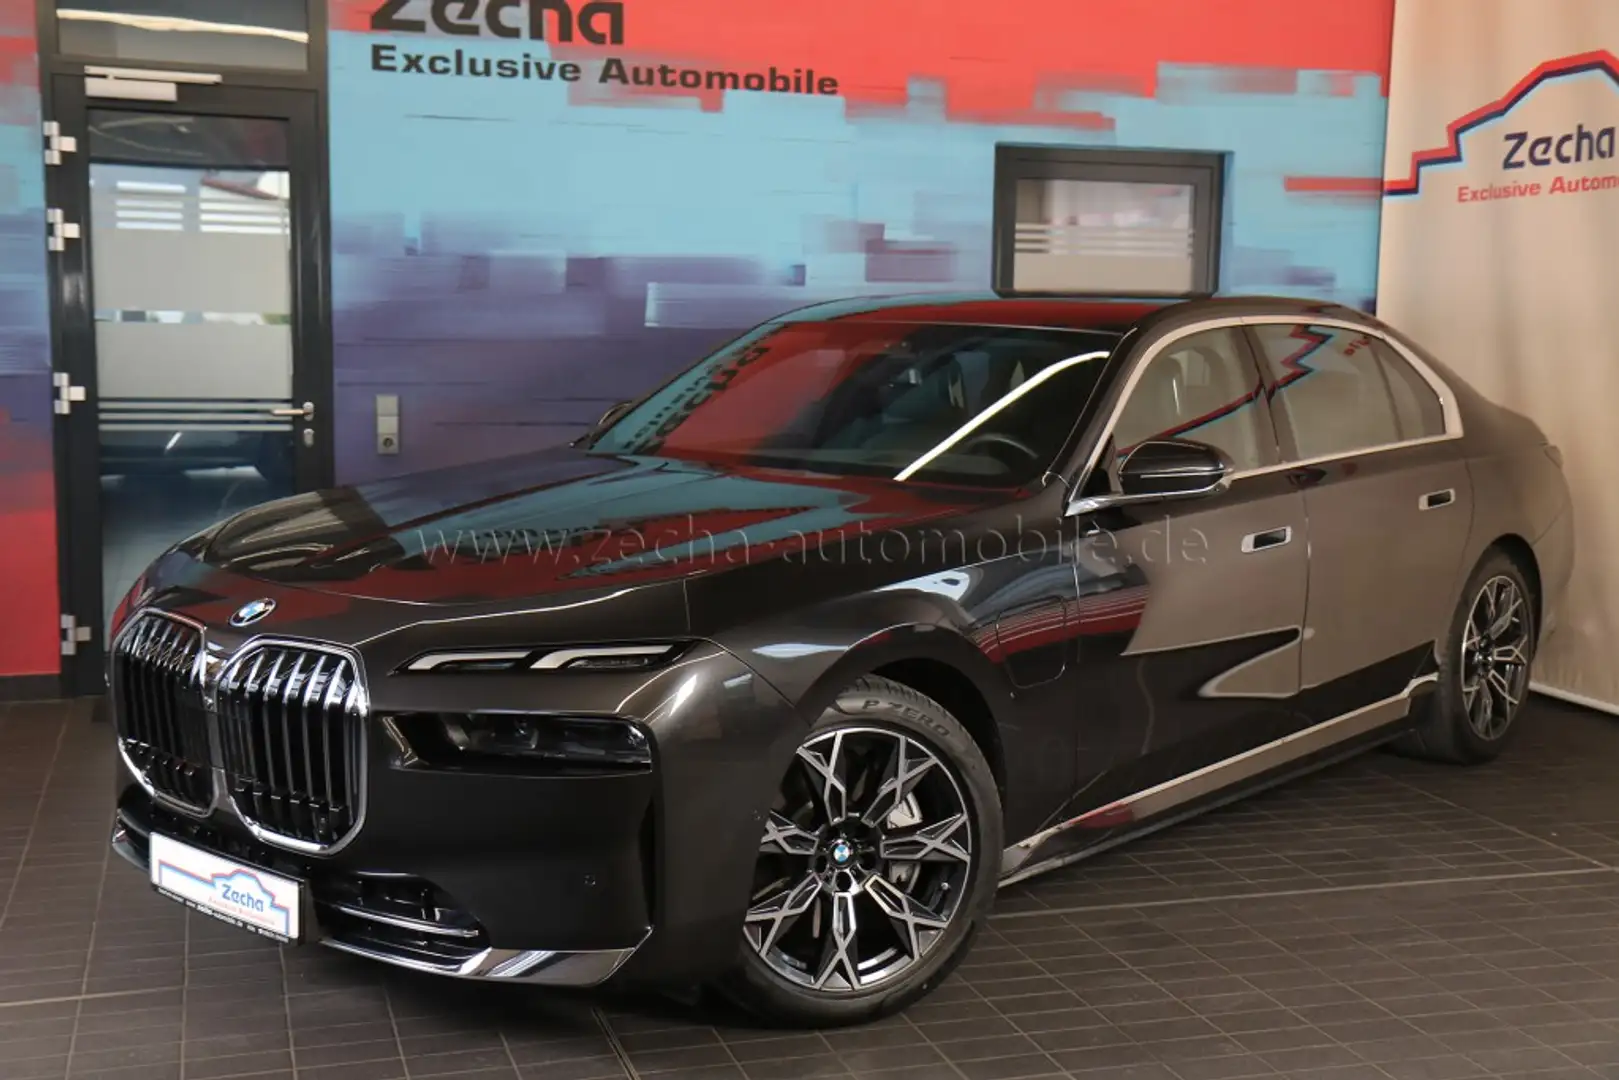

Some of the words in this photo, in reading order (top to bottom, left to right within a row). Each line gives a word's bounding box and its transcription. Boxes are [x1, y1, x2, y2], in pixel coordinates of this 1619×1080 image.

[371, 44, 582, 82] Exclusive
[598, 57, 839, 96] Automobile
[1503, 124, 1615, 170] Zecha
[1458, 181, 1541, 203] Exclusive
[1549, 175, 1619, 195] Autom
[862, 699, 880, 710] P
[888, 701, 951, 736] ZERO
[222, 884, 264, 912] Zecha
